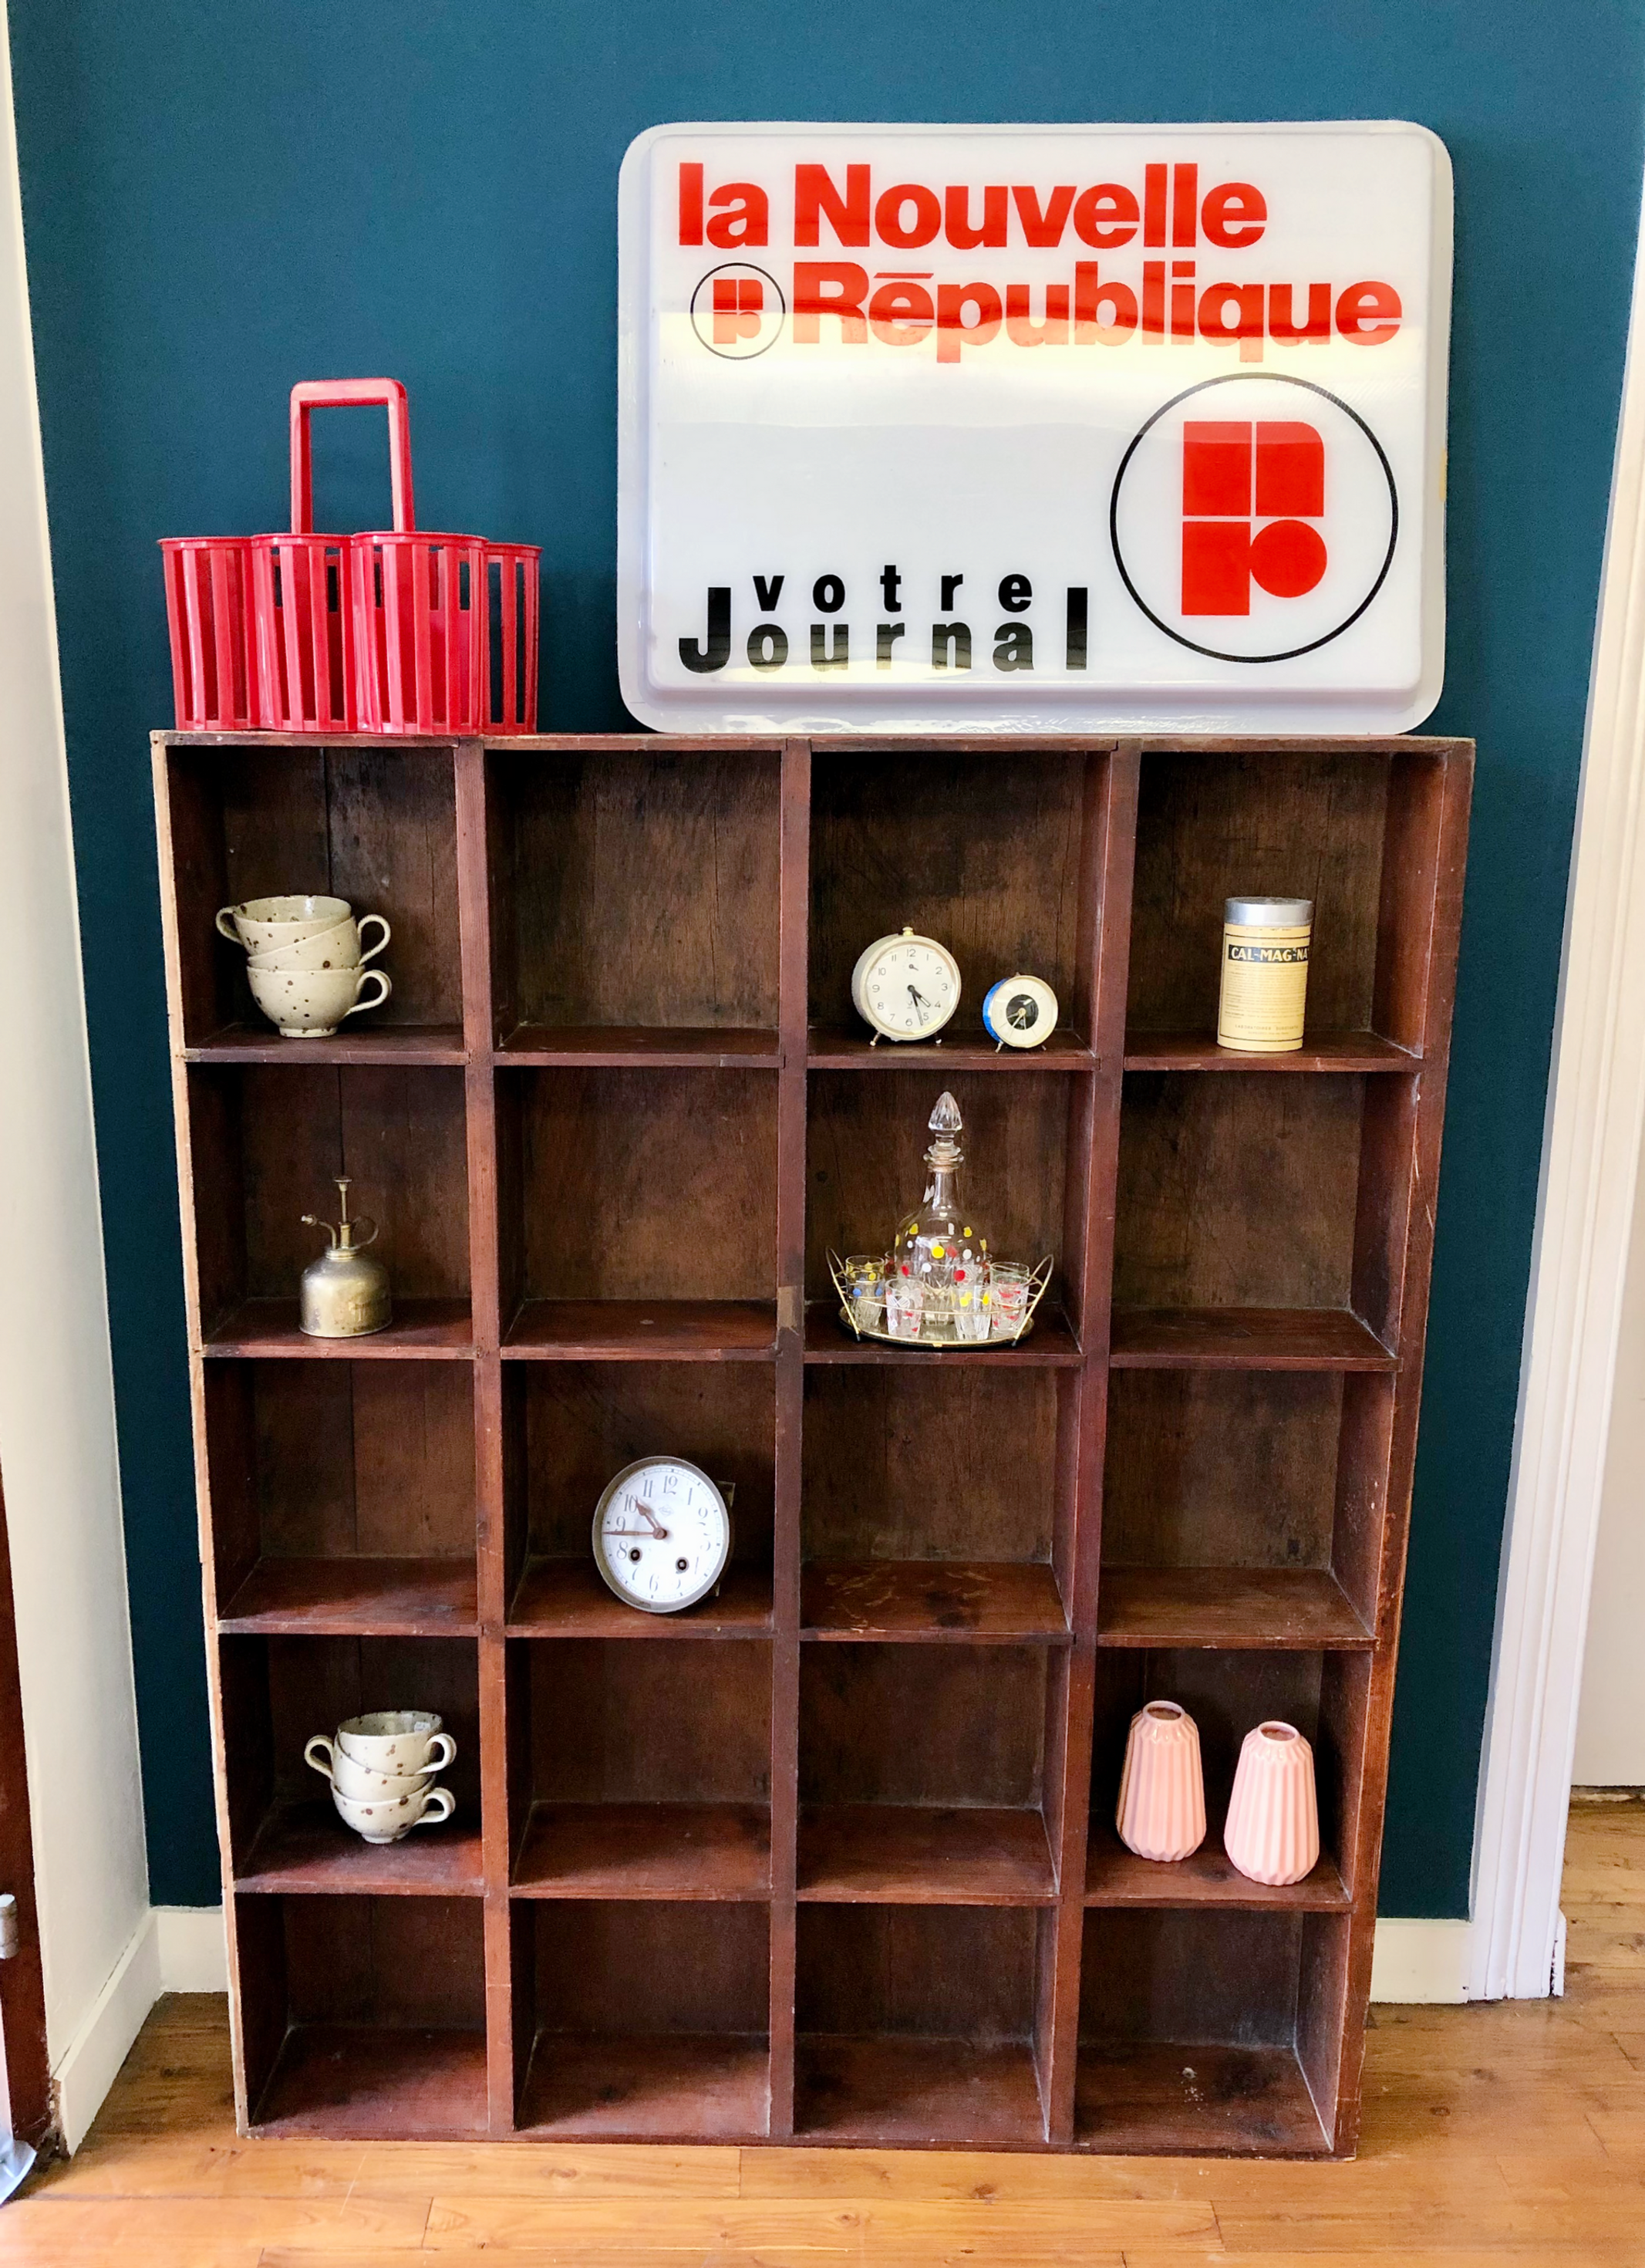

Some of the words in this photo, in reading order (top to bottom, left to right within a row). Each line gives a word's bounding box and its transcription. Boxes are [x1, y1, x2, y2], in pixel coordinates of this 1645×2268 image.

[679, 162, 769, 249] la
[794, 162, 1269, 250] Nouvelle
[752, 564, 1033, 614] votre
[678, 586, 1088, 674] Journal
[935, 967, 942, 975] 2
[941, 983, 948, 991] 3
[643, 1480, 653, 1498] 11
[663, 1476, 678, 1496] 12
[688, 1487, 693, 1506] 1
[617, 1541, 629, 1560] 8
